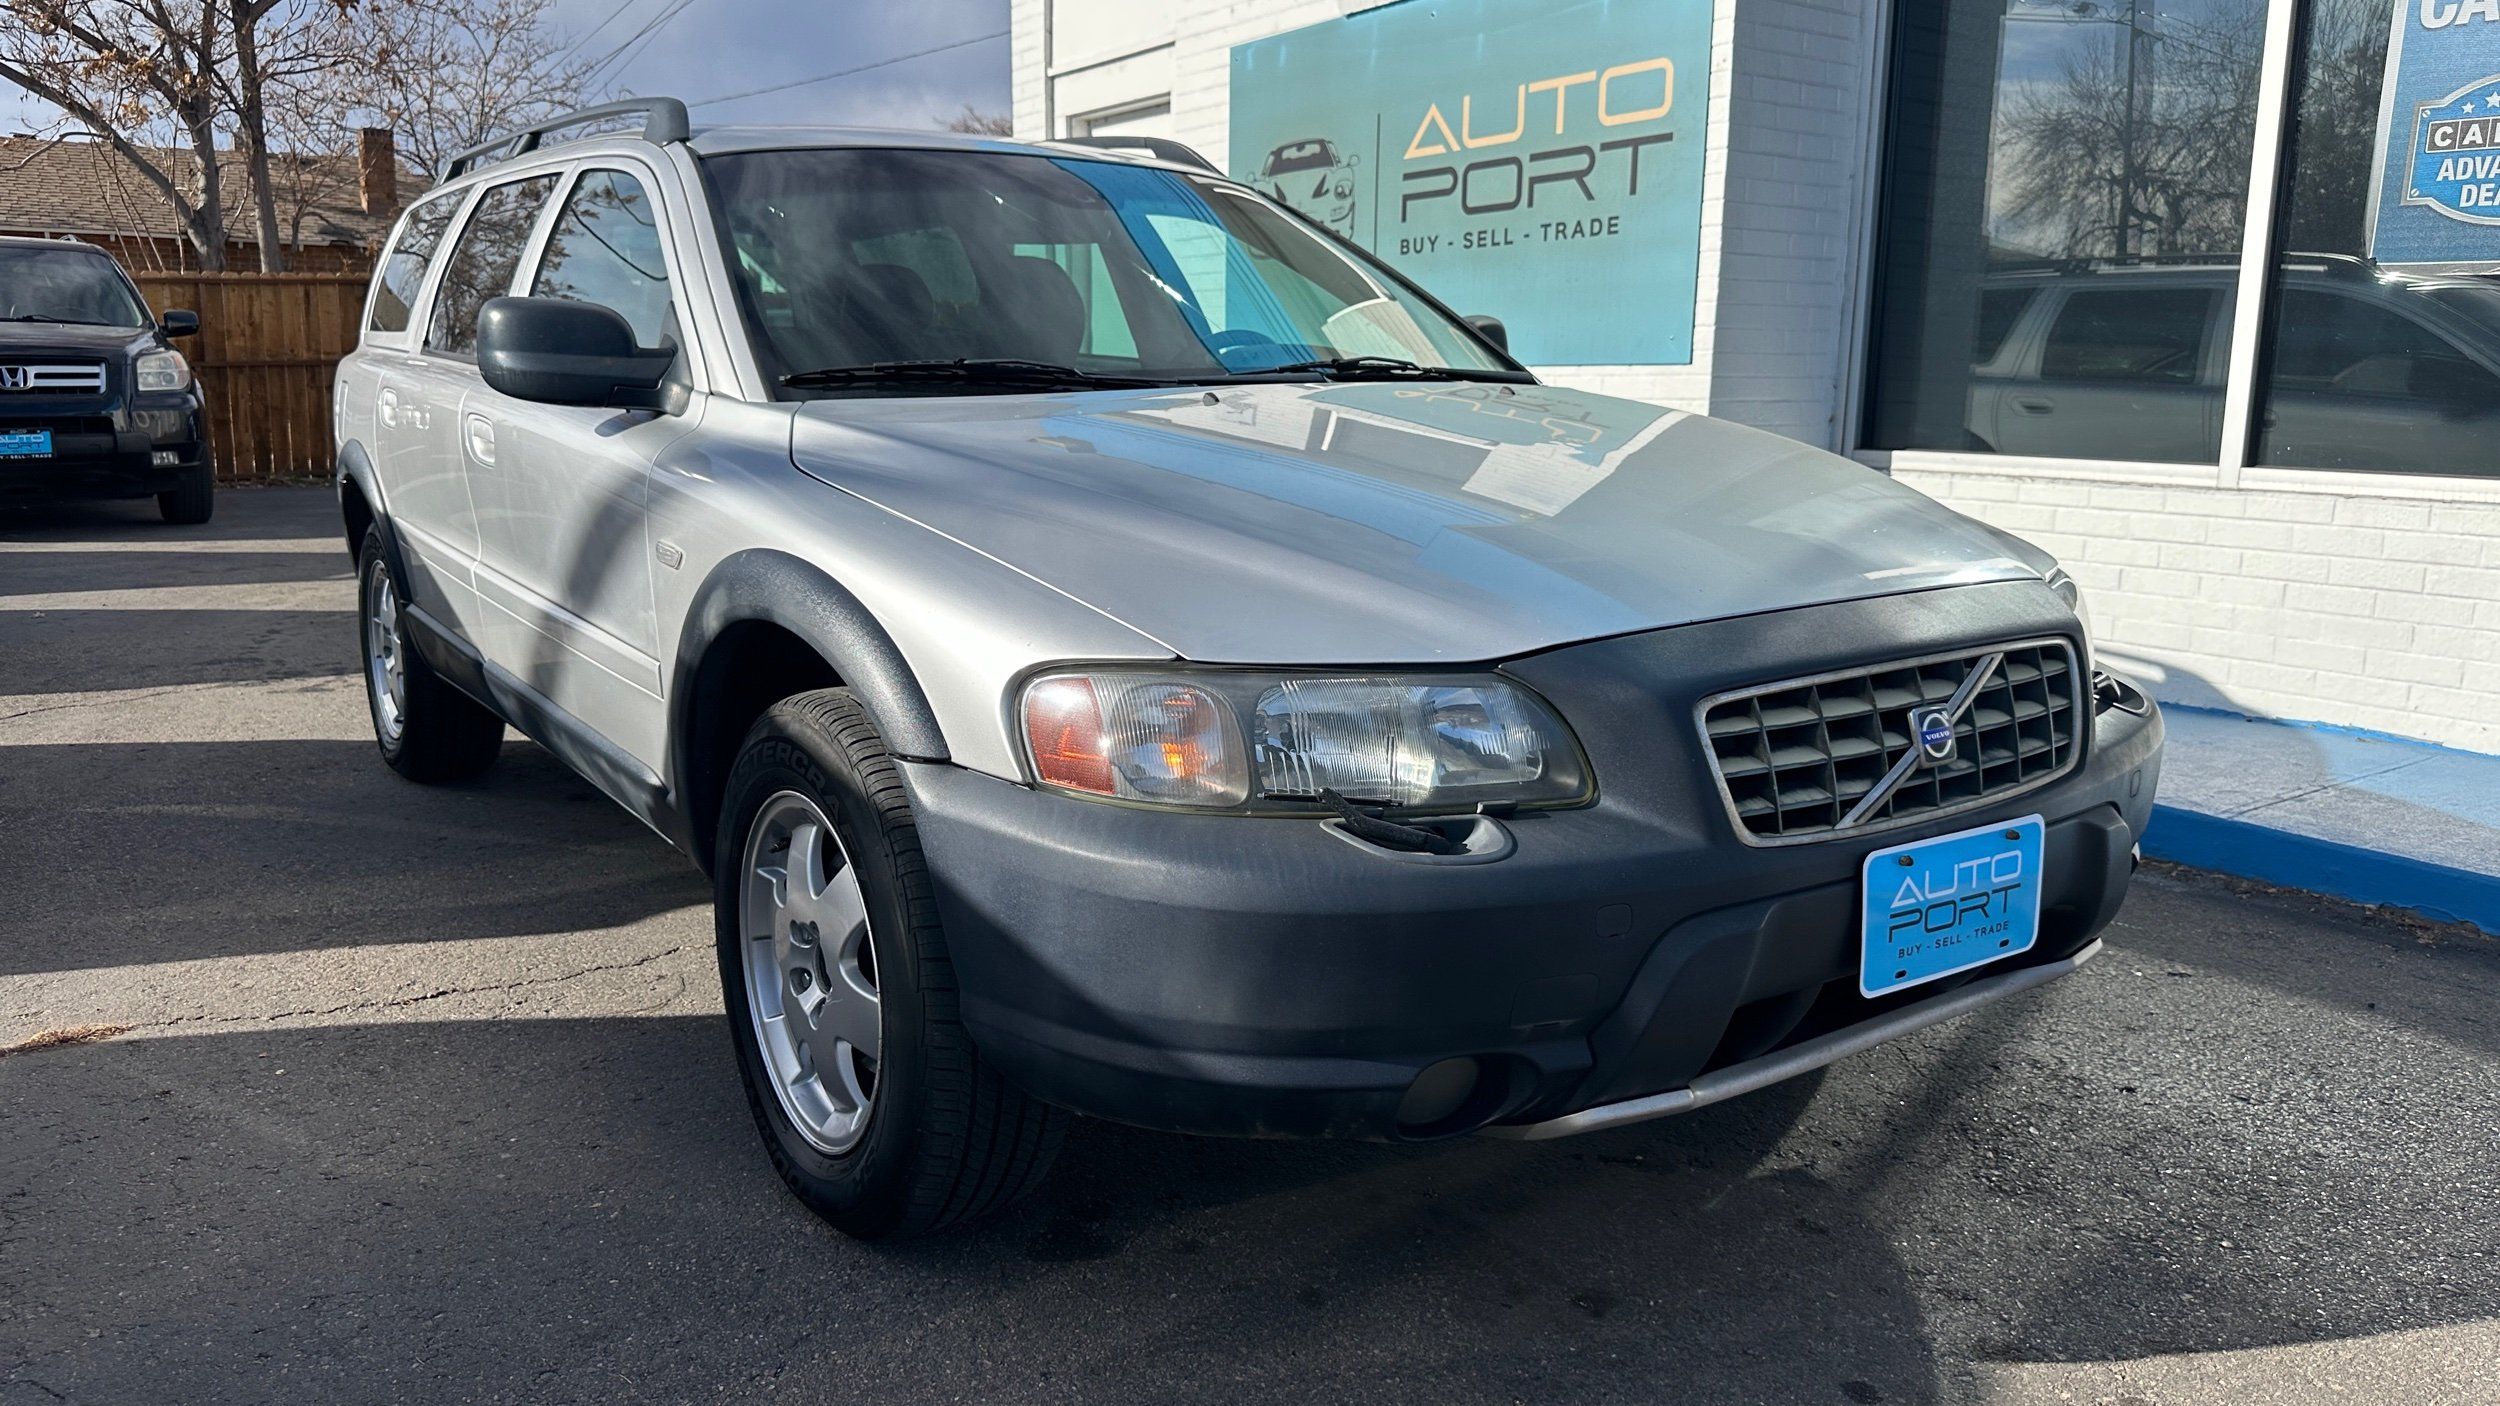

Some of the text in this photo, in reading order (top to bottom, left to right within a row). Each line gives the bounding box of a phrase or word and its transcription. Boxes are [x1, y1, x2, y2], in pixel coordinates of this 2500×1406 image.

[1403, 57, 1674, 160] AUTO
[1401, 132, 1674, 223] PORT
[1400, 235, 1439, 255] BUY
[1463, 227, 1514, 249] SELL
[1540, 216, 1620, 242] TRADE
[1925, 730, 1950, 741] VOLVO
[1890, 849, 2022, 909] AUTO
[1888, 882, 2022, 944] PORT
[1898, 943, 1922, 959] BUY
[1935, 934, 1962, 949] SELL
[1974, 921, 2009, 939] TRADE
